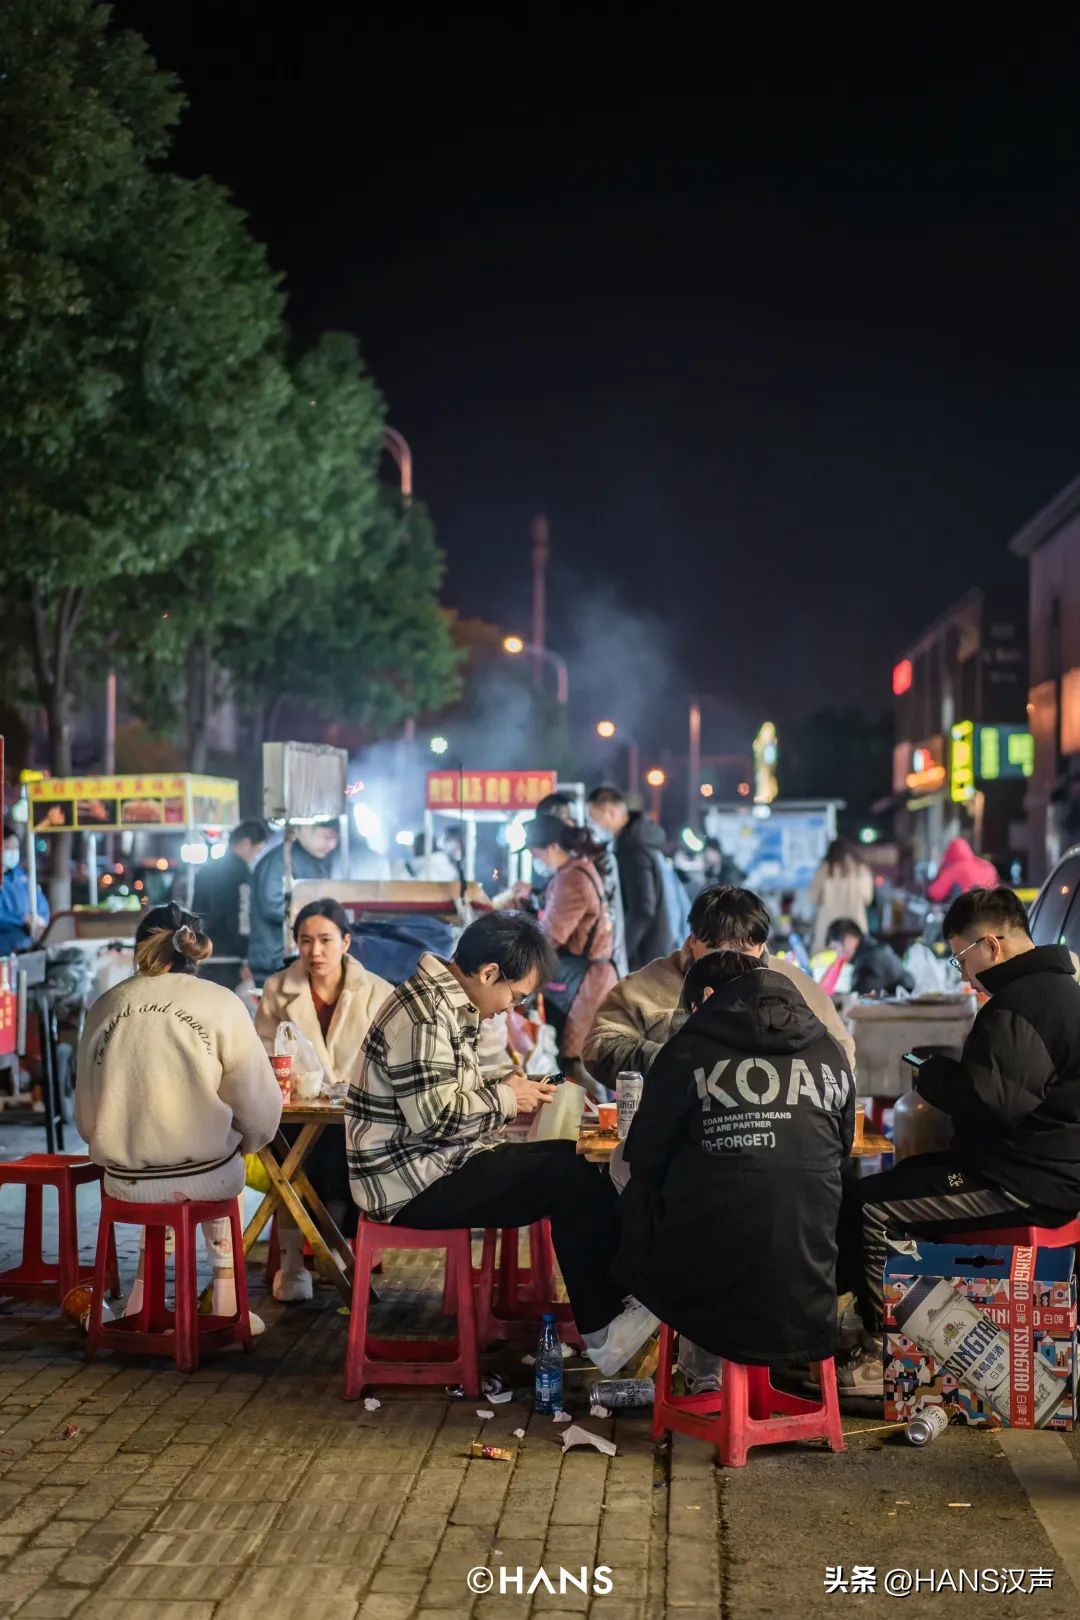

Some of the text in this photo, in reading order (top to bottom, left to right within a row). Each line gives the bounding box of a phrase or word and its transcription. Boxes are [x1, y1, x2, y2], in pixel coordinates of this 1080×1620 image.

[139, 1001, 172, 1013] and
[693, 1057, 850, 1111] KOAN
[703, 1111, 792, 1126] KOAN MAN IT'S MEANS
[716, 1123, 732, 1132] ARE
[733, 1120, 772, 1130] PARTNER
[1013, 1246, 1033, 1300] TSINGTAO
[944, 1315, 1000, 1379] SINGTAO
[1013, 1325, 1030, 1392] TSINGTAO
